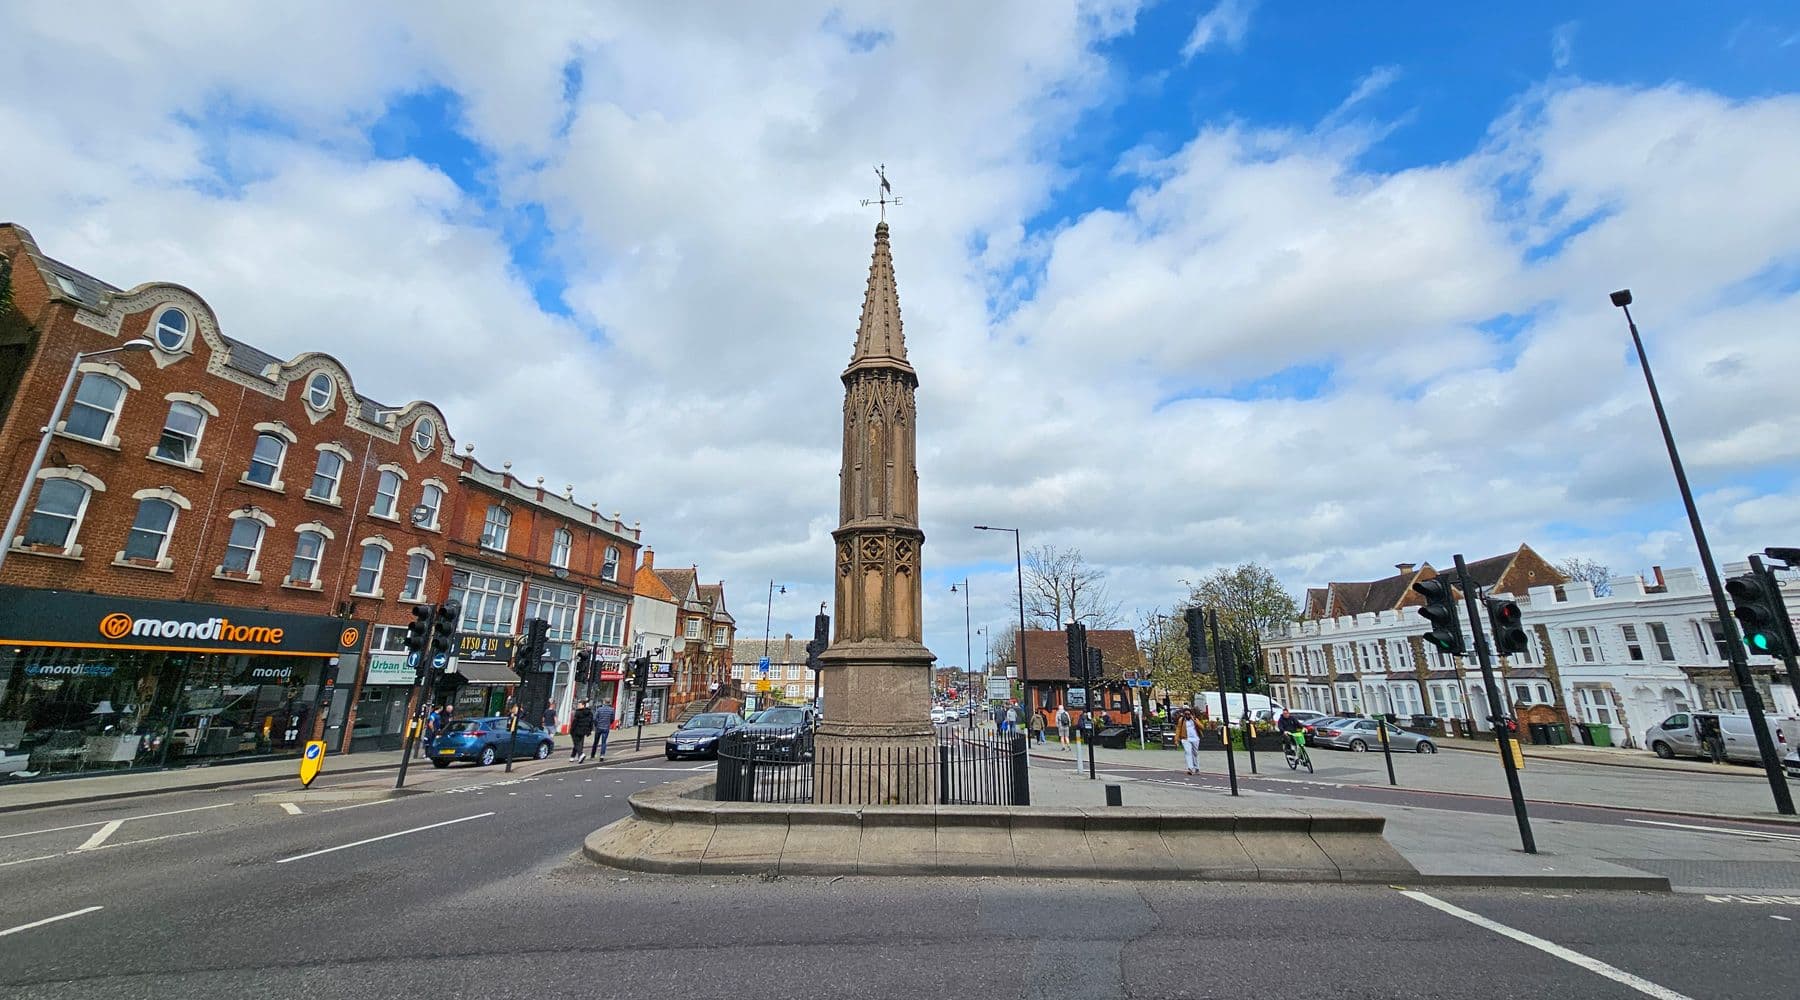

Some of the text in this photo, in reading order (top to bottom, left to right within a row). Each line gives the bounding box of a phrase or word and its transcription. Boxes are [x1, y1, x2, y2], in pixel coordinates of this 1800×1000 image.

[860, 199, 869, 207] W
[895, 197, 903, 205] E
[132, 617, 284, 643] mondihome
[481, 638, 487, 650] &
[372, 660, 400, 670] Urban
[252, 667, 292, 677] mondi
